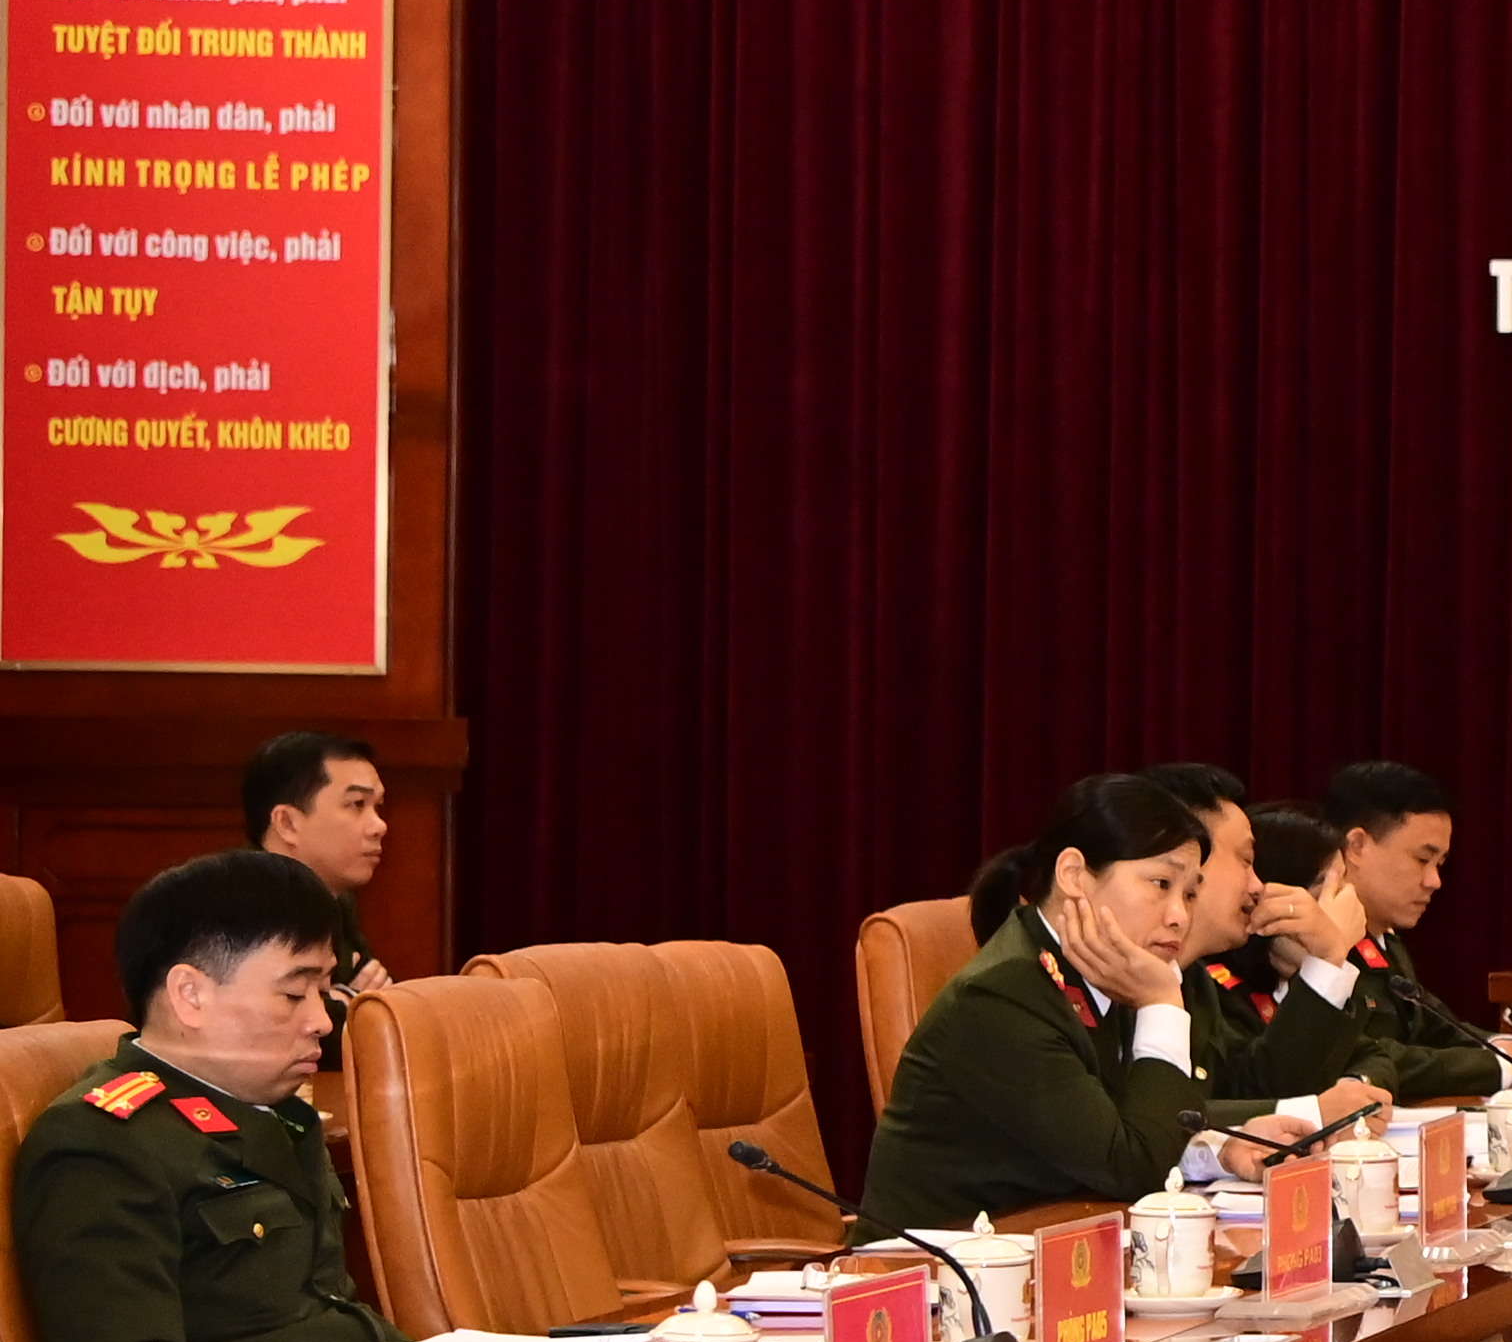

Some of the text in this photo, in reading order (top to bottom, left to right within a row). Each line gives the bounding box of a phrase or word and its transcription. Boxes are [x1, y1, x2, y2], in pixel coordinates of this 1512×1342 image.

[53, 18, 367, 60] TUYỆT ĐỐI TRUNG THÀNH
[51, 152, 371, 194] KÍNH TRỌNG LỄ PHÉP
[52, 281, 159, 322] TẬN TỤY
[47, 354, 271, 395] Đối với địch, phải
[48, 413, 351, 451] CƯƠNG QUYẾT, KHÔN KHÉO
